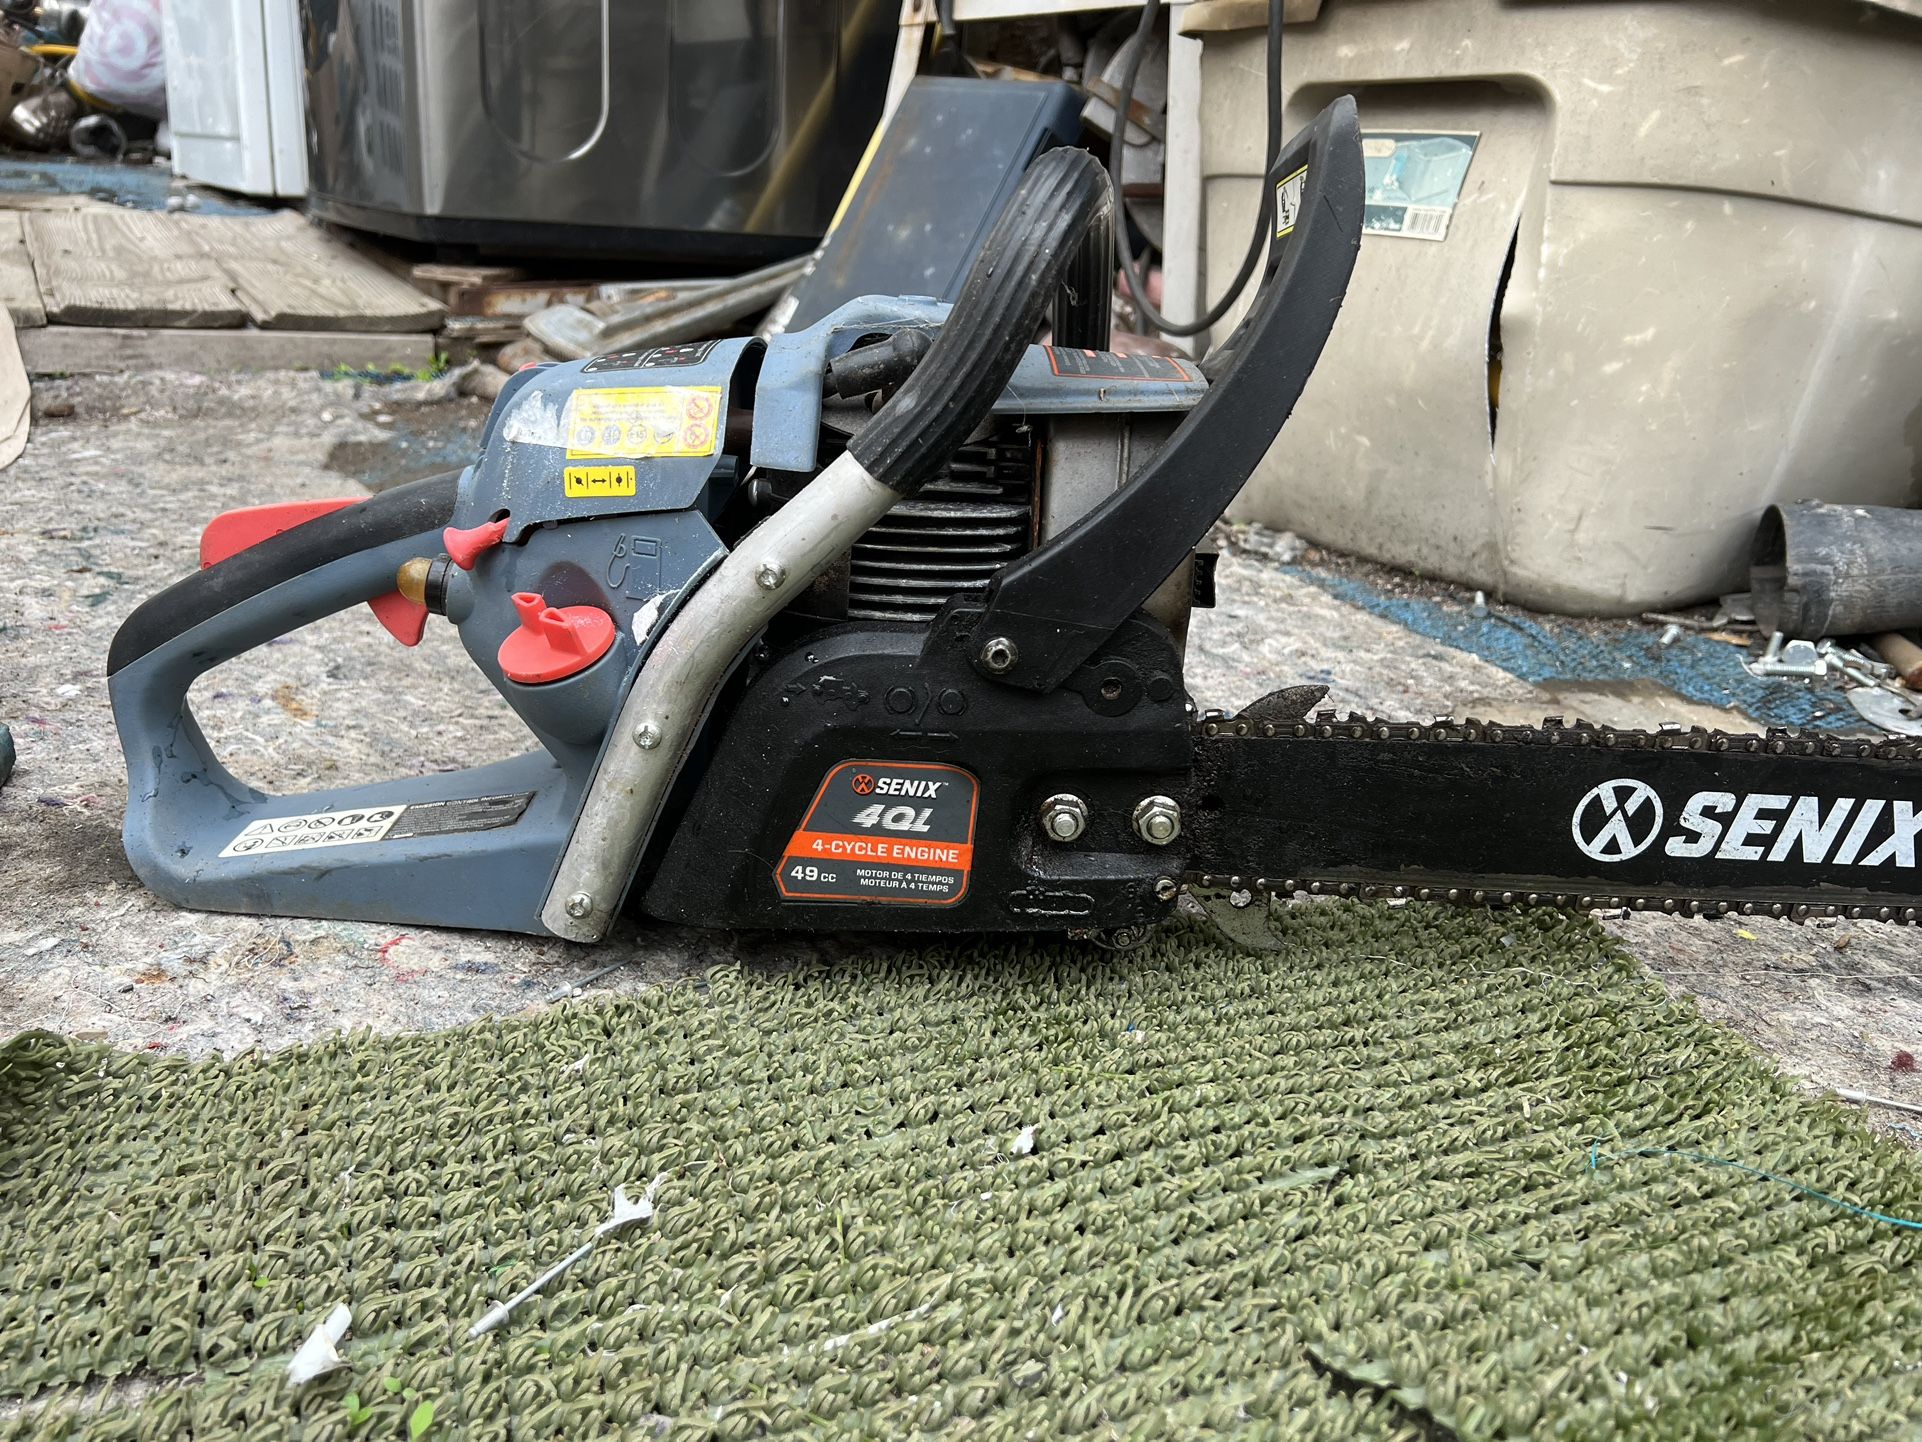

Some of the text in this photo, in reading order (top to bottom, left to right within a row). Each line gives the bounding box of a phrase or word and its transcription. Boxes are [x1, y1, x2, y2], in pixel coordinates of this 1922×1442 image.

[875, 777, 942, 799] SENIX
[446, 797, 479, 806] CONTROL
[851, 804, 934, 833] 4QL
[1665, 791, 1922, 868] SENIX
[812, 839, 959, 863] 4-CYCLE ENGINE
[791, 865, 818, 881] 49
[856, 869, 890, 879] MOTOR
[913, 873, 954, 884] TIEMPOS
[860, 878, 899, 888] MOTEUR
[901, 879, 908, 889] À
[918, 883, 949, 892] TEMPS
